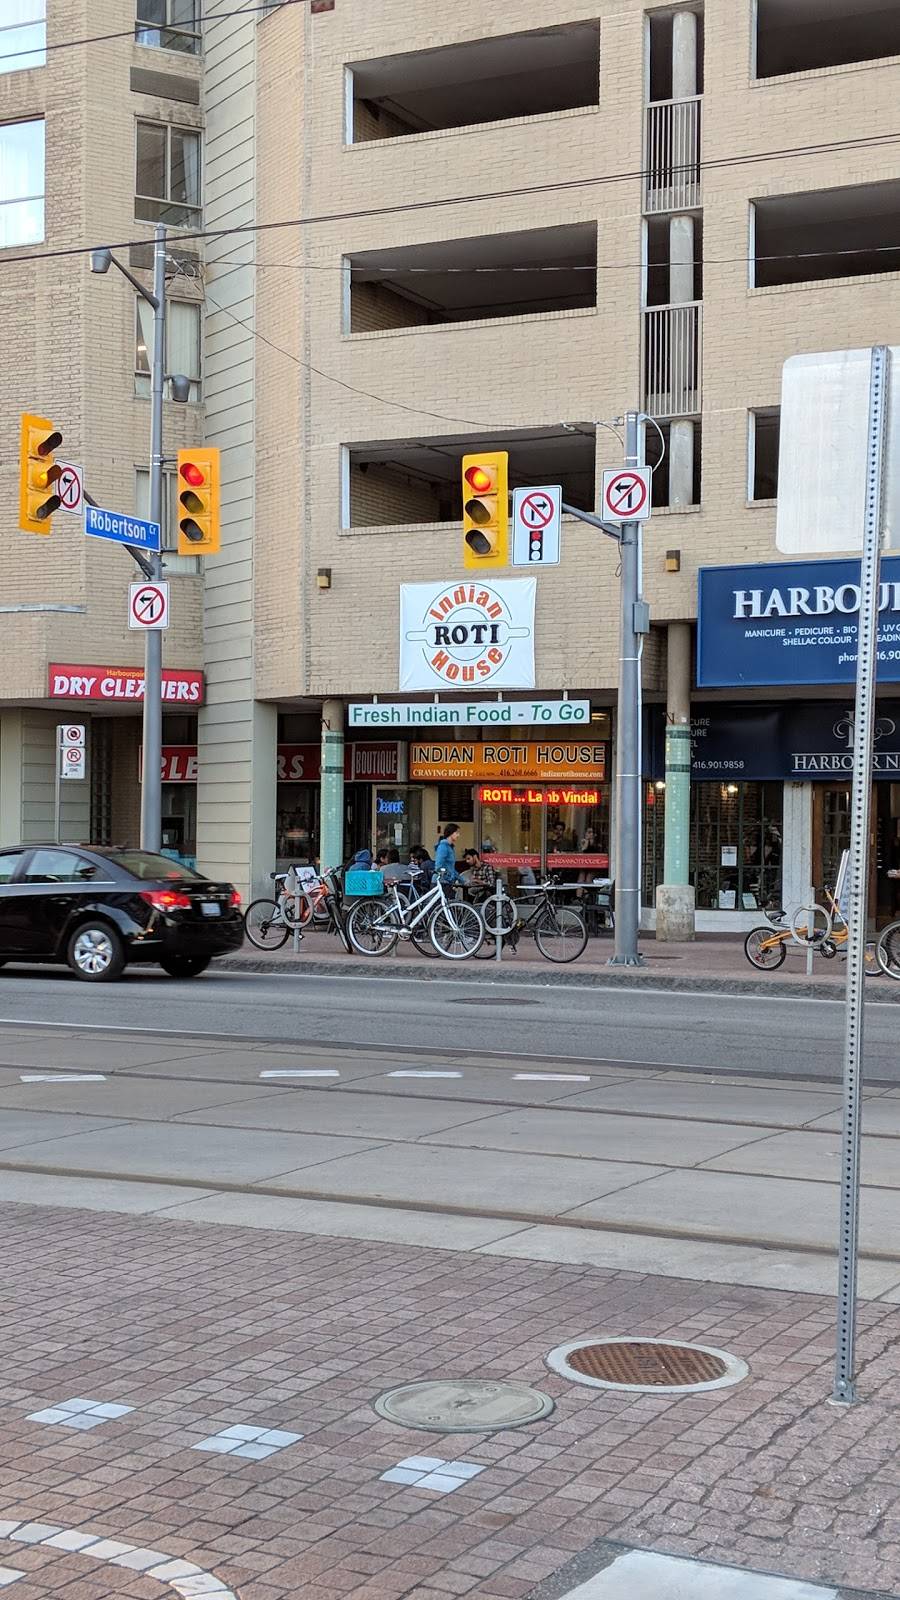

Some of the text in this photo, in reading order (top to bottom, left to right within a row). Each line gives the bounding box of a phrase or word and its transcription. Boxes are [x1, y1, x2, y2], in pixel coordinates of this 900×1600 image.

[90, 509, 157, 541] Robertson Cr
[429, 584, 504, 622] Indian
[433, 624, 500, 646] ROTI
[745, 628, 786, 638] MANICURE
[794, 626, 834, 636] PEDICURE
[842, 625, 858, 635] BIO
[782, 636, 817, 646] SHELLAC
[817, 635, 852, 645] COLOUR
[106, 669, 147, 678] Harbourpoin
[430, 646, 504, 682] House
[53, 675, 200, 700] DRY CLEAERS
[353, 707, 401, 723] Fresh
[406, 706, 460, 722] Indian
[466, 705, 512, 722] Food
[532, 705, 552, 721] To
[559, 704, 585, 720] Go
[356, 750, 397, 776] BOUTIQUE
[412, 745, 605, 764] INDIAN ROTI HOUSE
[794, 755, 881, 769] HARBOR
[412, 769, 448, 777] CRAVING
[483, 790, 512, 802] ROTI
[562, 791, 598, 804] Vindal
